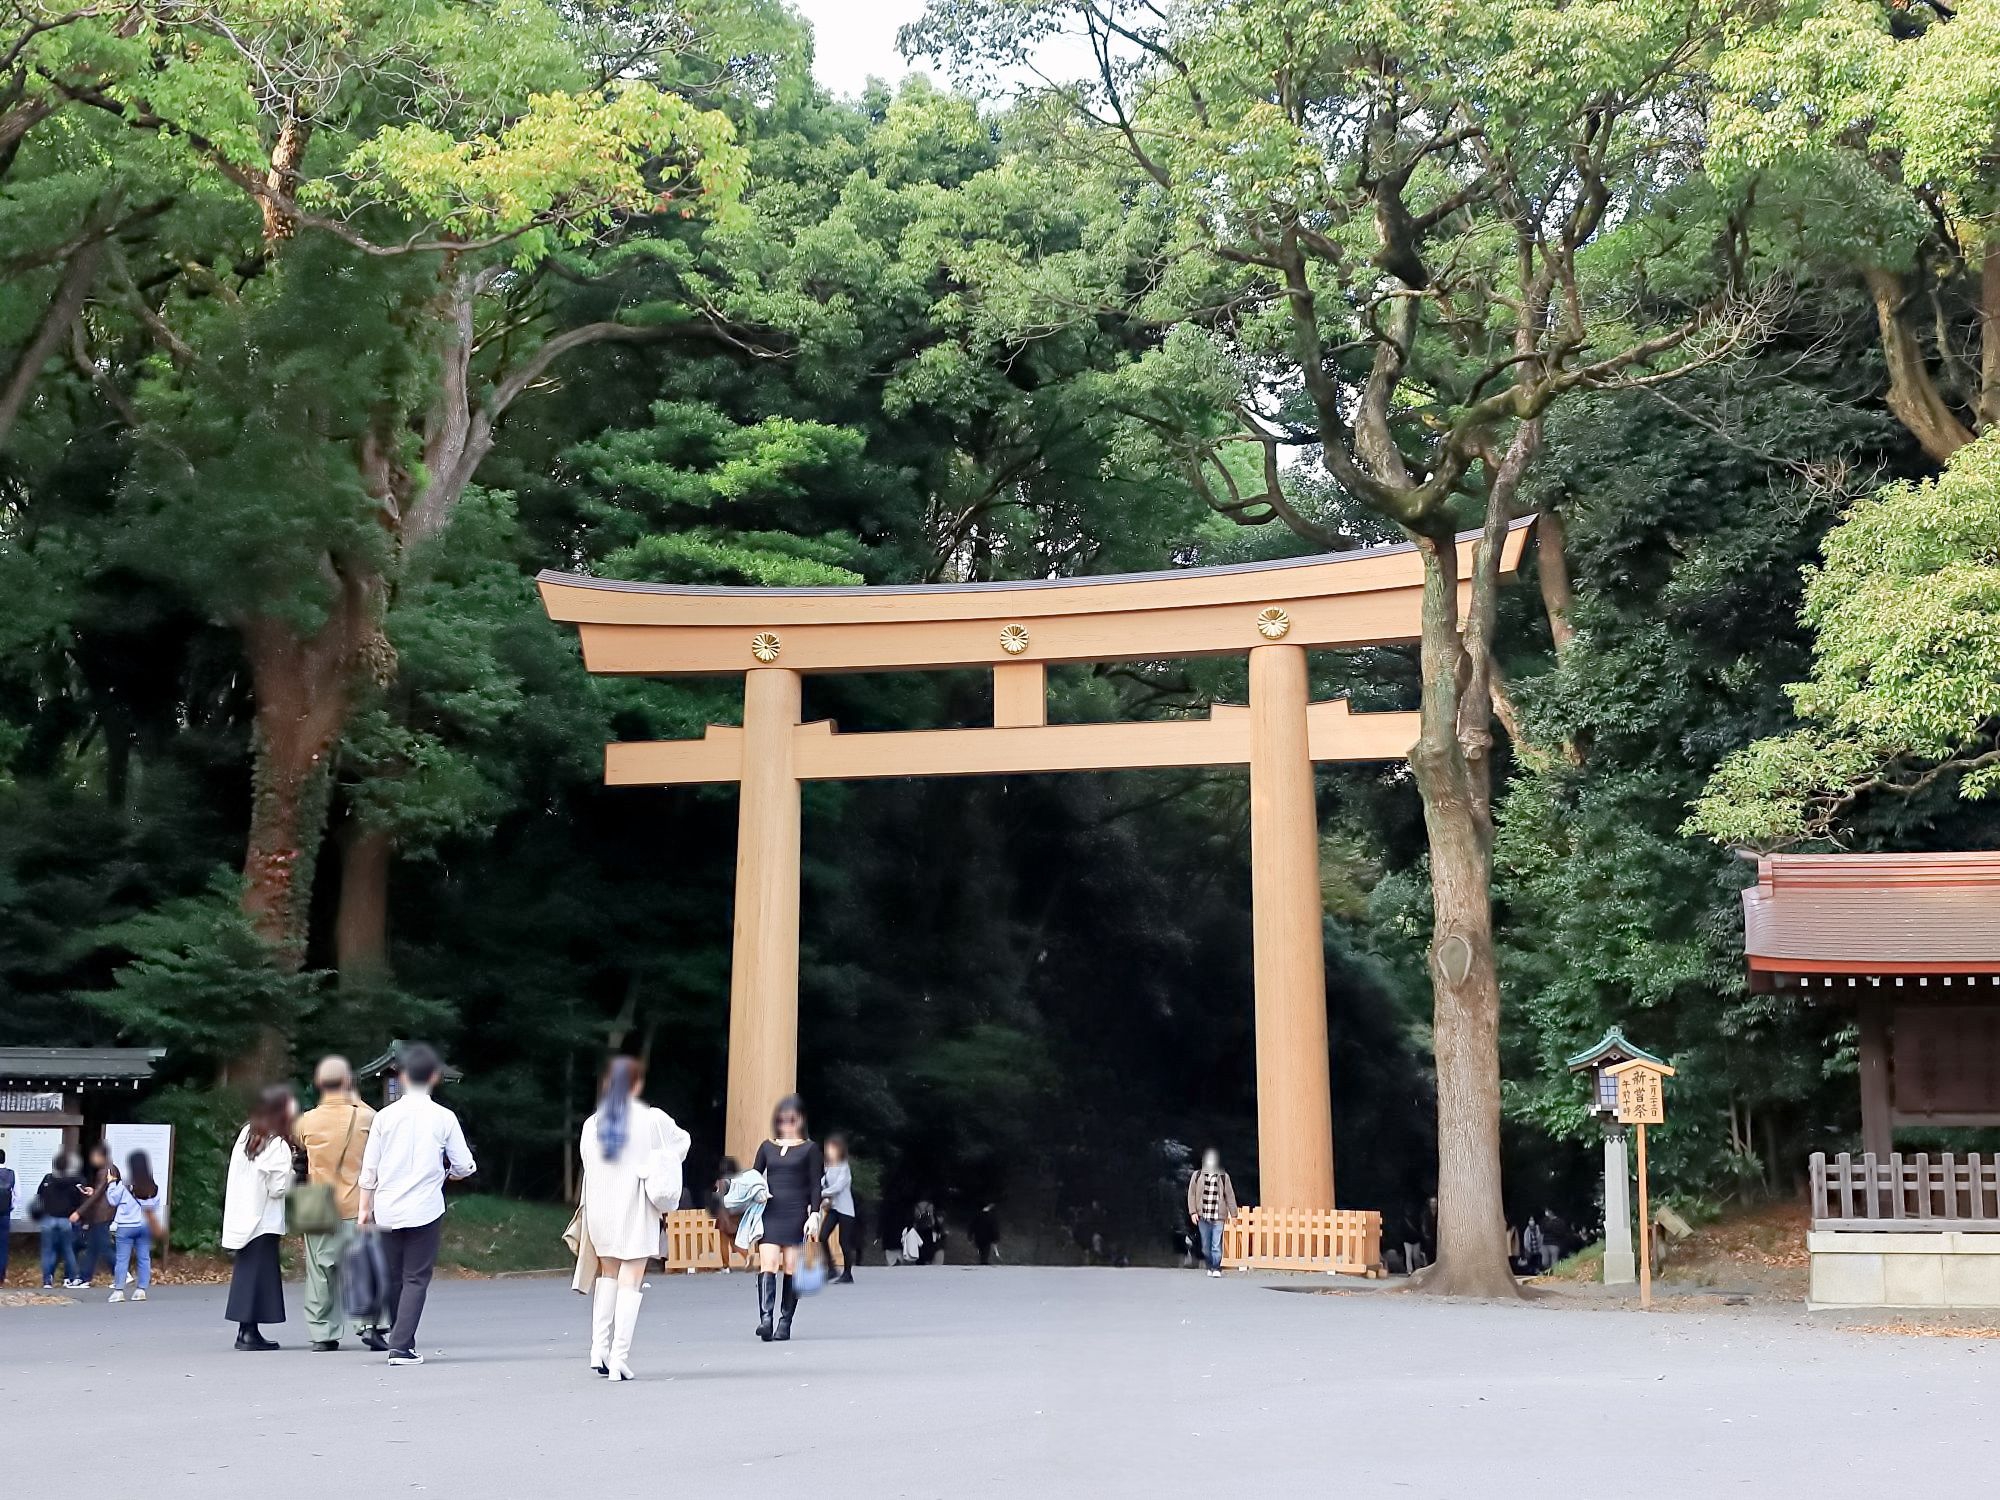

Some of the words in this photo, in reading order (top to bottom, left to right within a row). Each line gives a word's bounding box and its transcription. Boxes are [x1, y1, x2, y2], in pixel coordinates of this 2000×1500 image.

[1622, 1080, 1631, 1116] 午前十時
[1632, 1071, 1648, 1118] 新嘗祭
[1649, 1077, 1658, 1117] 十一月二十三日
